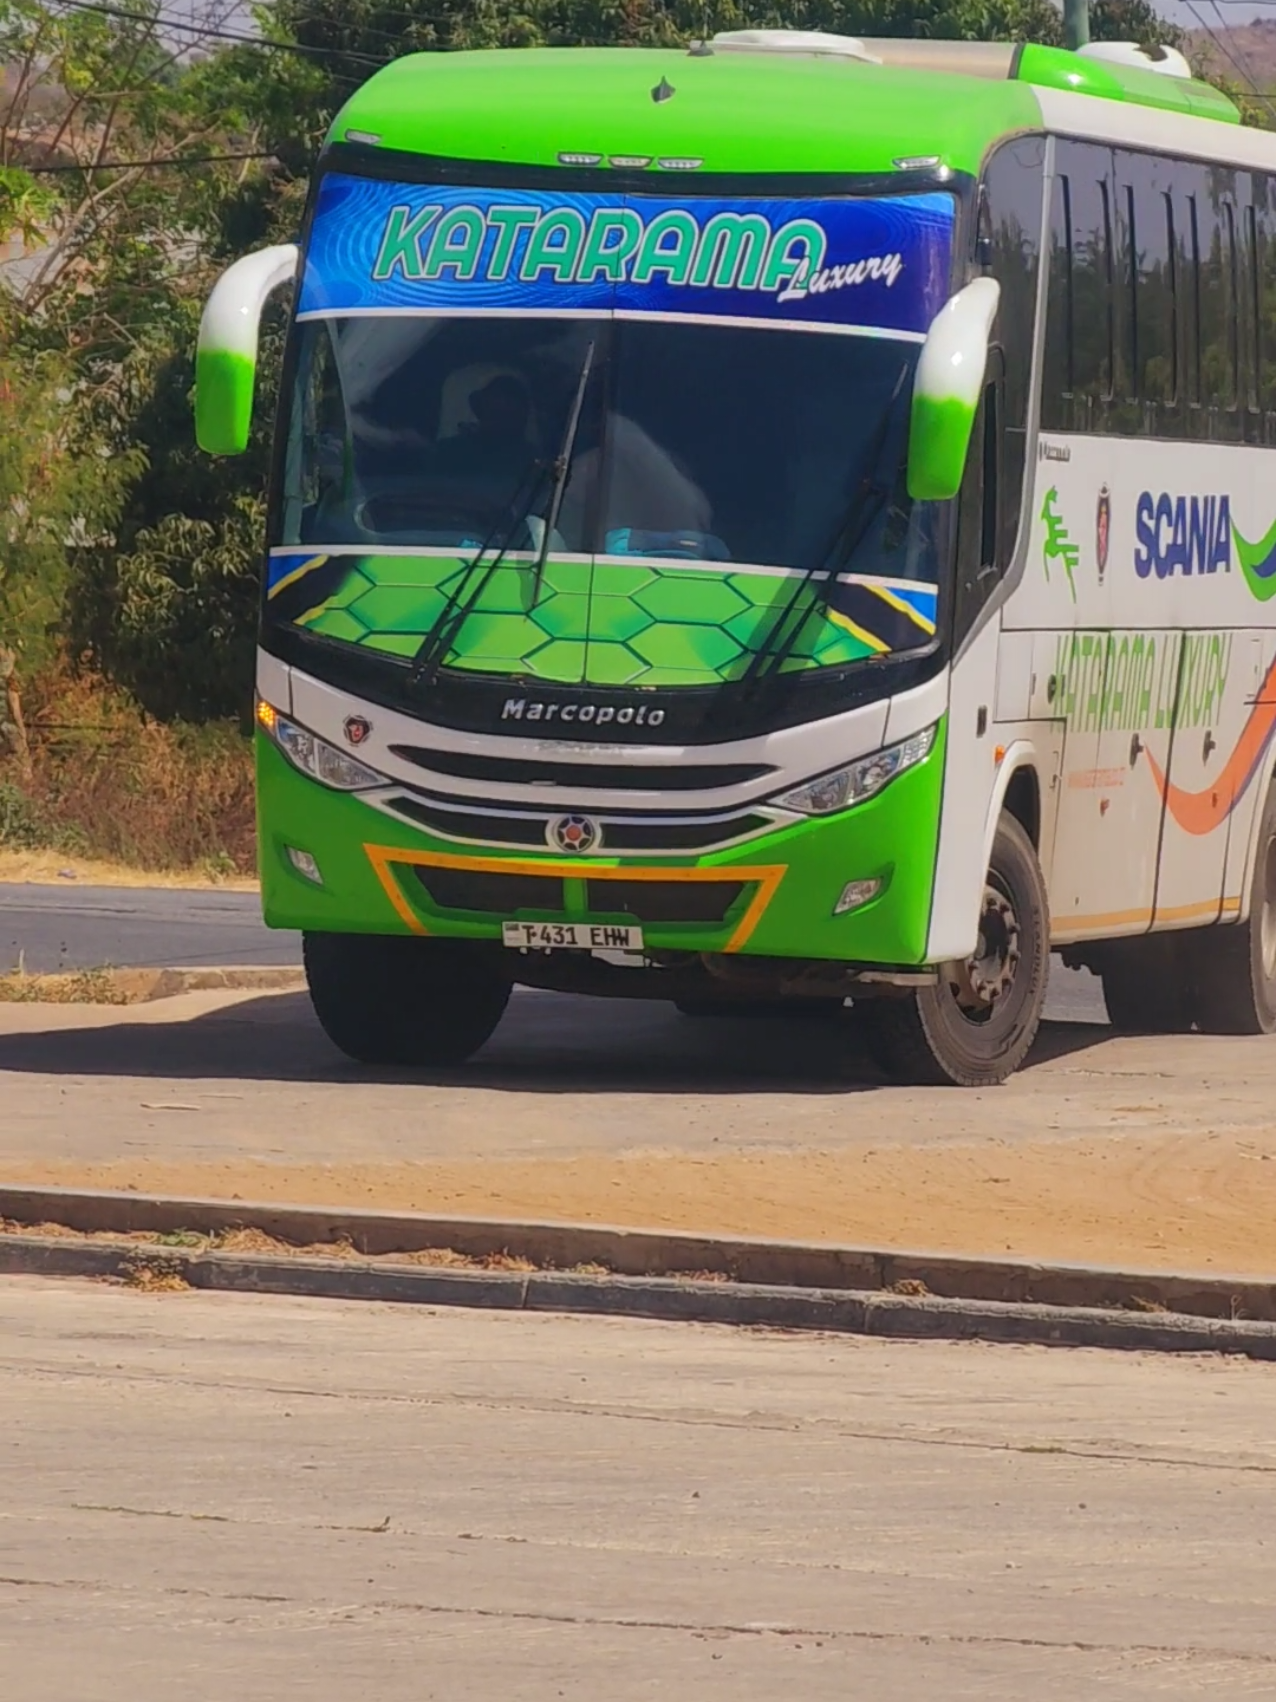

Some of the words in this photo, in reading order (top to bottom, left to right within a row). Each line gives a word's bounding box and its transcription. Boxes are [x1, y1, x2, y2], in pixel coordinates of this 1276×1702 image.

[371, 204, 827, 292] KATARAMA
[776, 252, 905, 303] Luxury
[1133, 490, 1231, 580] SCANIA
[501, 698, 665, 726] Marcopolo
[521, 924, 535, 945] T
[540, 924, 579, 946] 431
